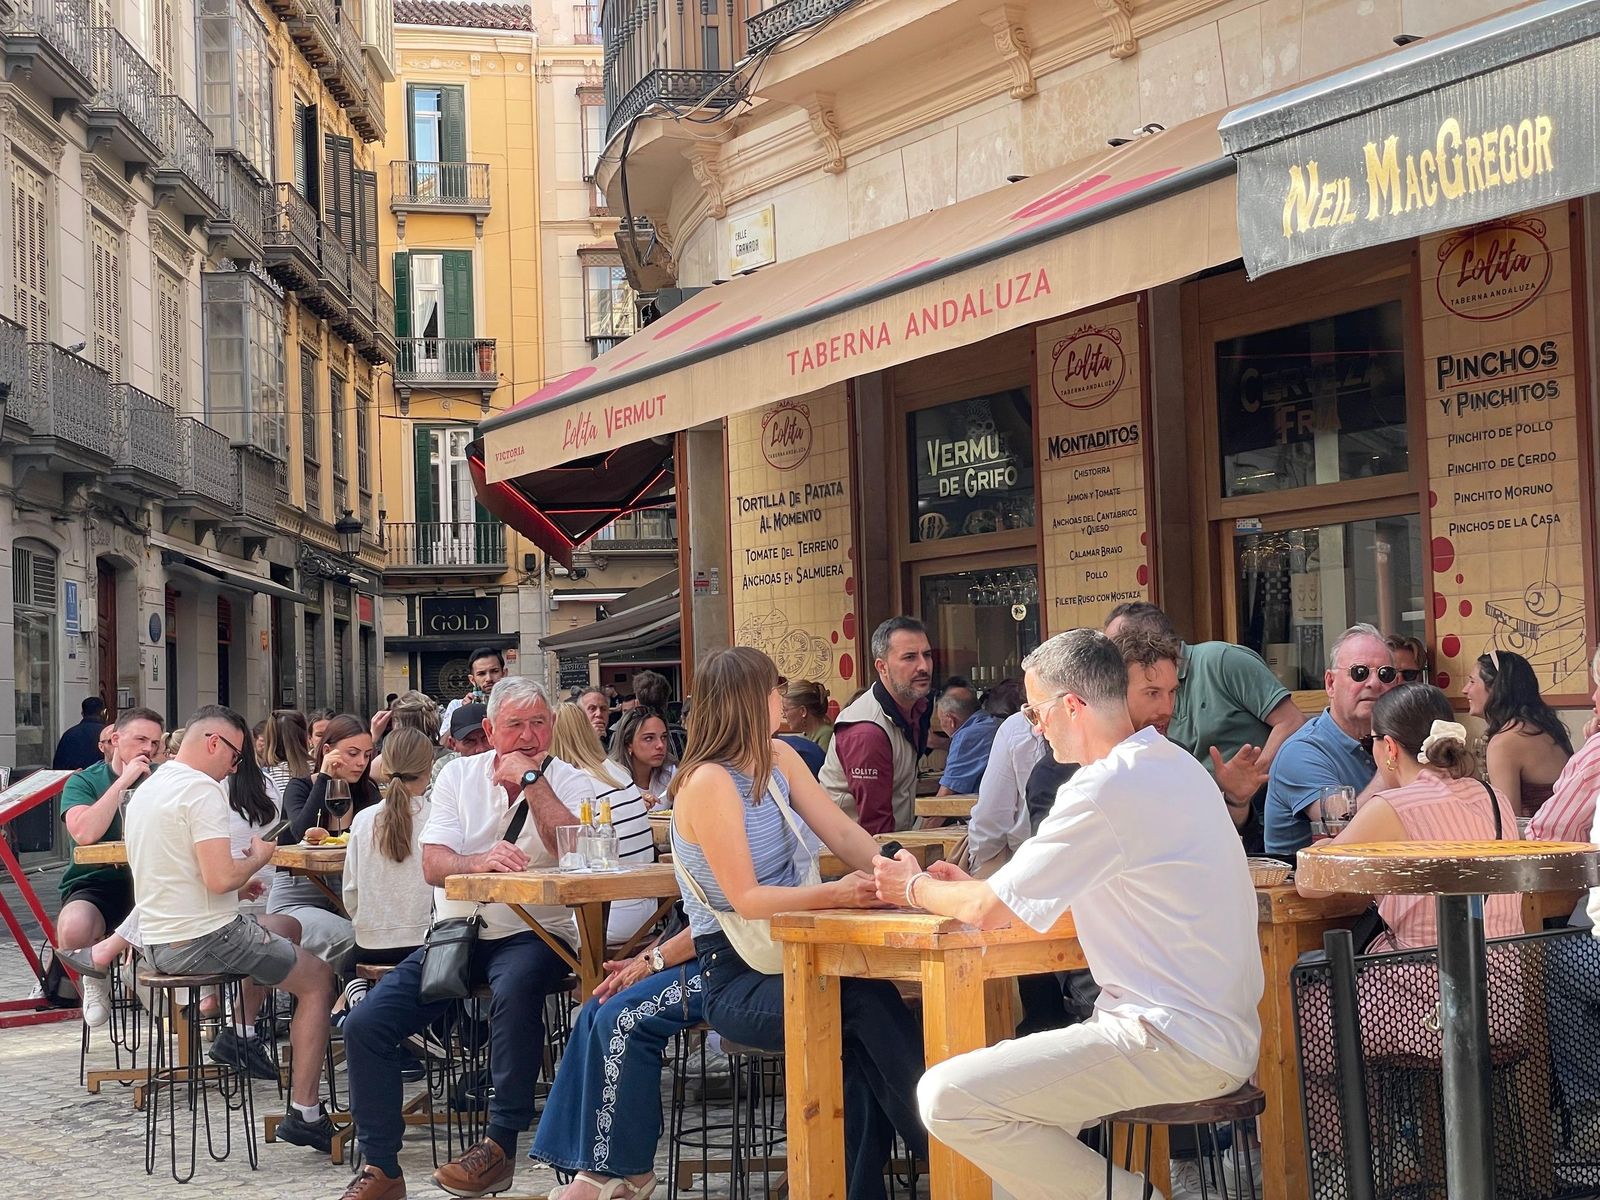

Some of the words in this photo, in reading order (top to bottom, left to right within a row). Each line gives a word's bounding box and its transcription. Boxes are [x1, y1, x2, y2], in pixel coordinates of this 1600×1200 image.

[1456, 238, 1532, 288] Lolita
[1450, 292, 1488, 306] TABERNA
[1490, 282, 1537, 298] ANDALUZA
[787, 321, 892, 375] TABERNA
[905, 267, 1052, 340] ANDALUZA
[1064, 343, 1113, 382] Lolita
[1437, 341, 1558, 391] PINCHOS
[1060, 386, 1086, 396] TABERNA
[1086, 379, 1117, 392] ANDALUZA
[1440, 398, 1451, 415] Y
[1457, 380, 1559, 417] PINCHITOS
[562, 411, 598, 451] Lolita
[604, 394, 666, 438] VERMUT
[770, 416, 803, 447] Lolita
[1447, 429, 1496, 448] PINCHITO
[1498, 426, 1512, 438] DE
[1515, 420, 1553, 438] POLLO
[495, 445, 525, 462] VICTORIA
[1048, 423, 1139, 460] MONTADITOS
[927, 434, 1001, 477] VERMU
[1447, 459, 1496, 477] PINCHITO
[1500, 456, 1515, 468] DE
[1517, 451, 1557, 468] CERDO
[939, 476, 961, 498] DE
[964, 464, 1018, 499] GRIFO
[1073, 466, 1111, 480] CHISTORRA
[737, 492, 785, 516] TORTILLA
[789, 491, 800, 507] DE
[804, 481, 844, 505] PATATA
[1067, 493, 1089, 505] JAMON
[1089, 491, 1095, 500] Y
[1095, 487, 1122, 501] TOMATE
[1453, 488, 1503, 506] PINCHITO
[1504, 482, 1553, 500] MORUNO
[760, 515, 771, 533] AL
[773, 508, 821, 531] MOMENTO
[1052, 516, 1082, 530] ANCHOAS
[1083, 515, 1095, 524] DEL
[1096, 508, 1138, 523] CANTABRICO
[1081, 527, 1086, 536] Y
[1086, 523, 1110, 537] QUESO
[1448, 521, 1495, 537] PINCHOS
[1497, 519, 1512, 529] DE
[1513, 517, 1528, 528] LA
[1530, 513, 1561, 529] CASA
[746, 547, 779, 566] TOMATE
[781, 547, 795, 562] DEL
[797, 538, 838, 557] TERRENO
[1069, 549, 1100, 561] CALAMAR
[1100, 545, 1123, 557] BRAVO
[742, 572, 782, 591] ANCHOAS
[784, 571, 794, 586] EN
[796, 564, 843, 584] SALMUERA
[1085, 570, 1109, 582] POLLO
[1077, 595, 1096, 606] RUSO
[1096, 593, 1110, 603] CON
[1110, 590, 1142, 603] MOSTAZA
[431, 614, 489, 631] GOLD
